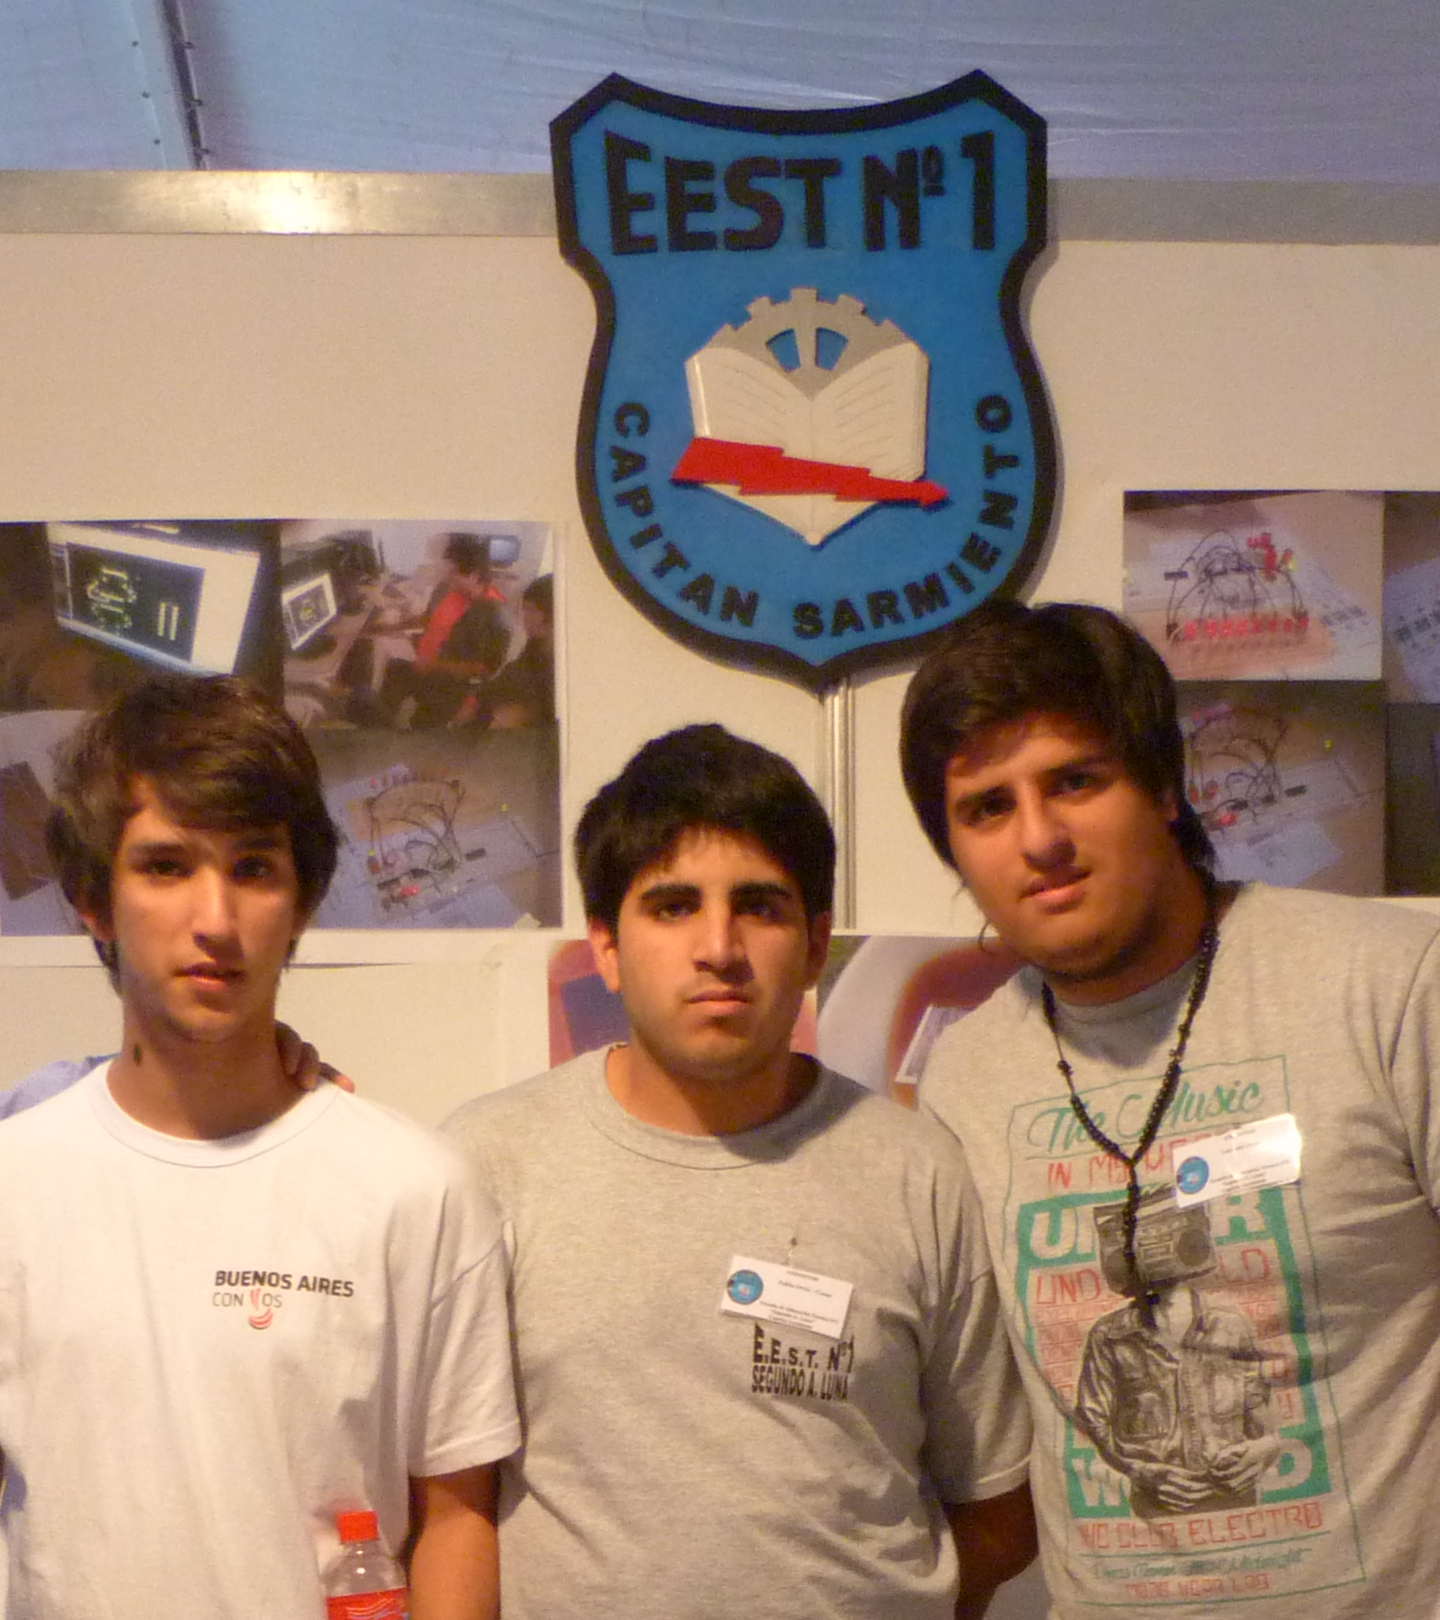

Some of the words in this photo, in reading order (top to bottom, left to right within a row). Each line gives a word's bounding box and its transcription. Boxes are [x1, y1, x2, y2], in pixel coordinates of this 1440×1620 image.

[605, 129, 842, 256] EEST
[608, 401, 759, 628] CAPITAN
[792, 394, 1020, 639] SARMIENTO
[1027, 1098, 1106, 1153] The
[1047, 1161, 1073, 1189] IN
[212, 1292, 245, 1308] CON
[214, 1270, 293, 1290] BUENOS
[297, 1275, 354, 1298] AIRES
[751, 1364, 806, 1396] SEGUNDO
[1188, 1501, 1323, 1546] ELECTRO
